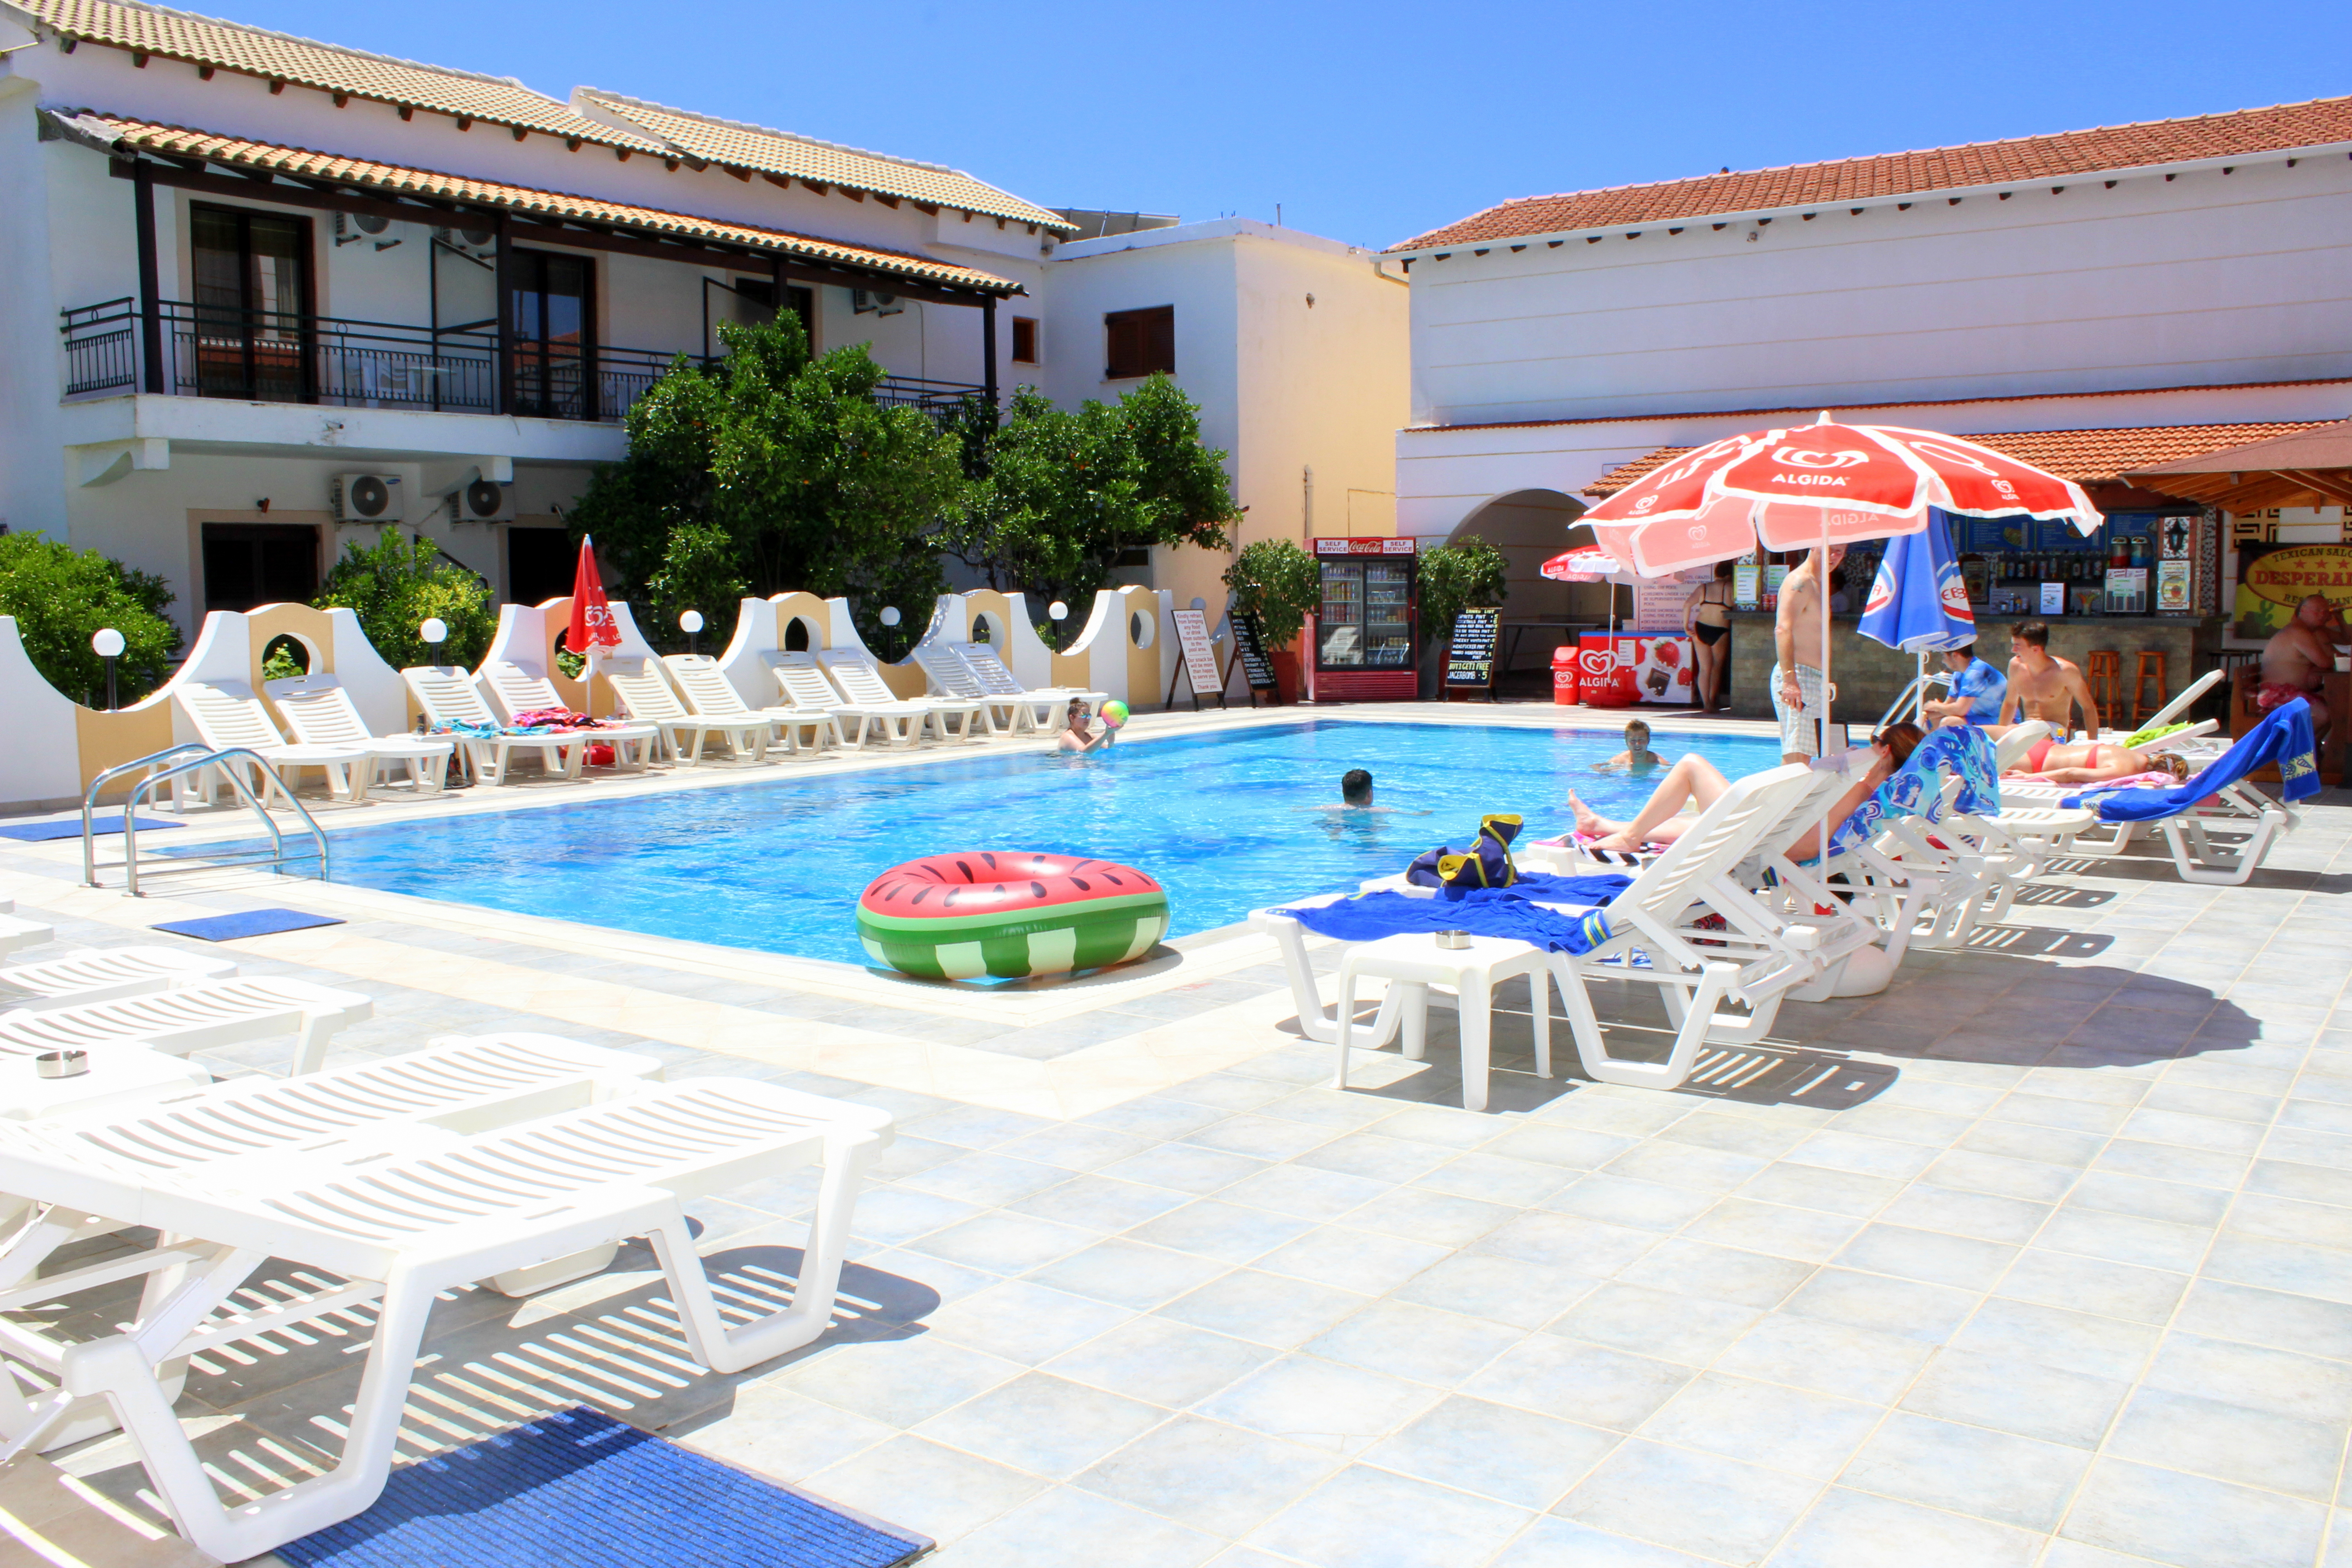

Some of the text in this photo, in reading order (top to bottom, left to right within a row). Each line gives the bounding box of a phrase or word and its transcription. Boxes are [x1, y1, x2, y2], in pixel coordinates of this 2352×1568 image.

[1771, 474, 1847, 486] ALGIDA
[2272, 548, 2324, 562] TEXICAN
[1481, 671, 1488, 680] 5
